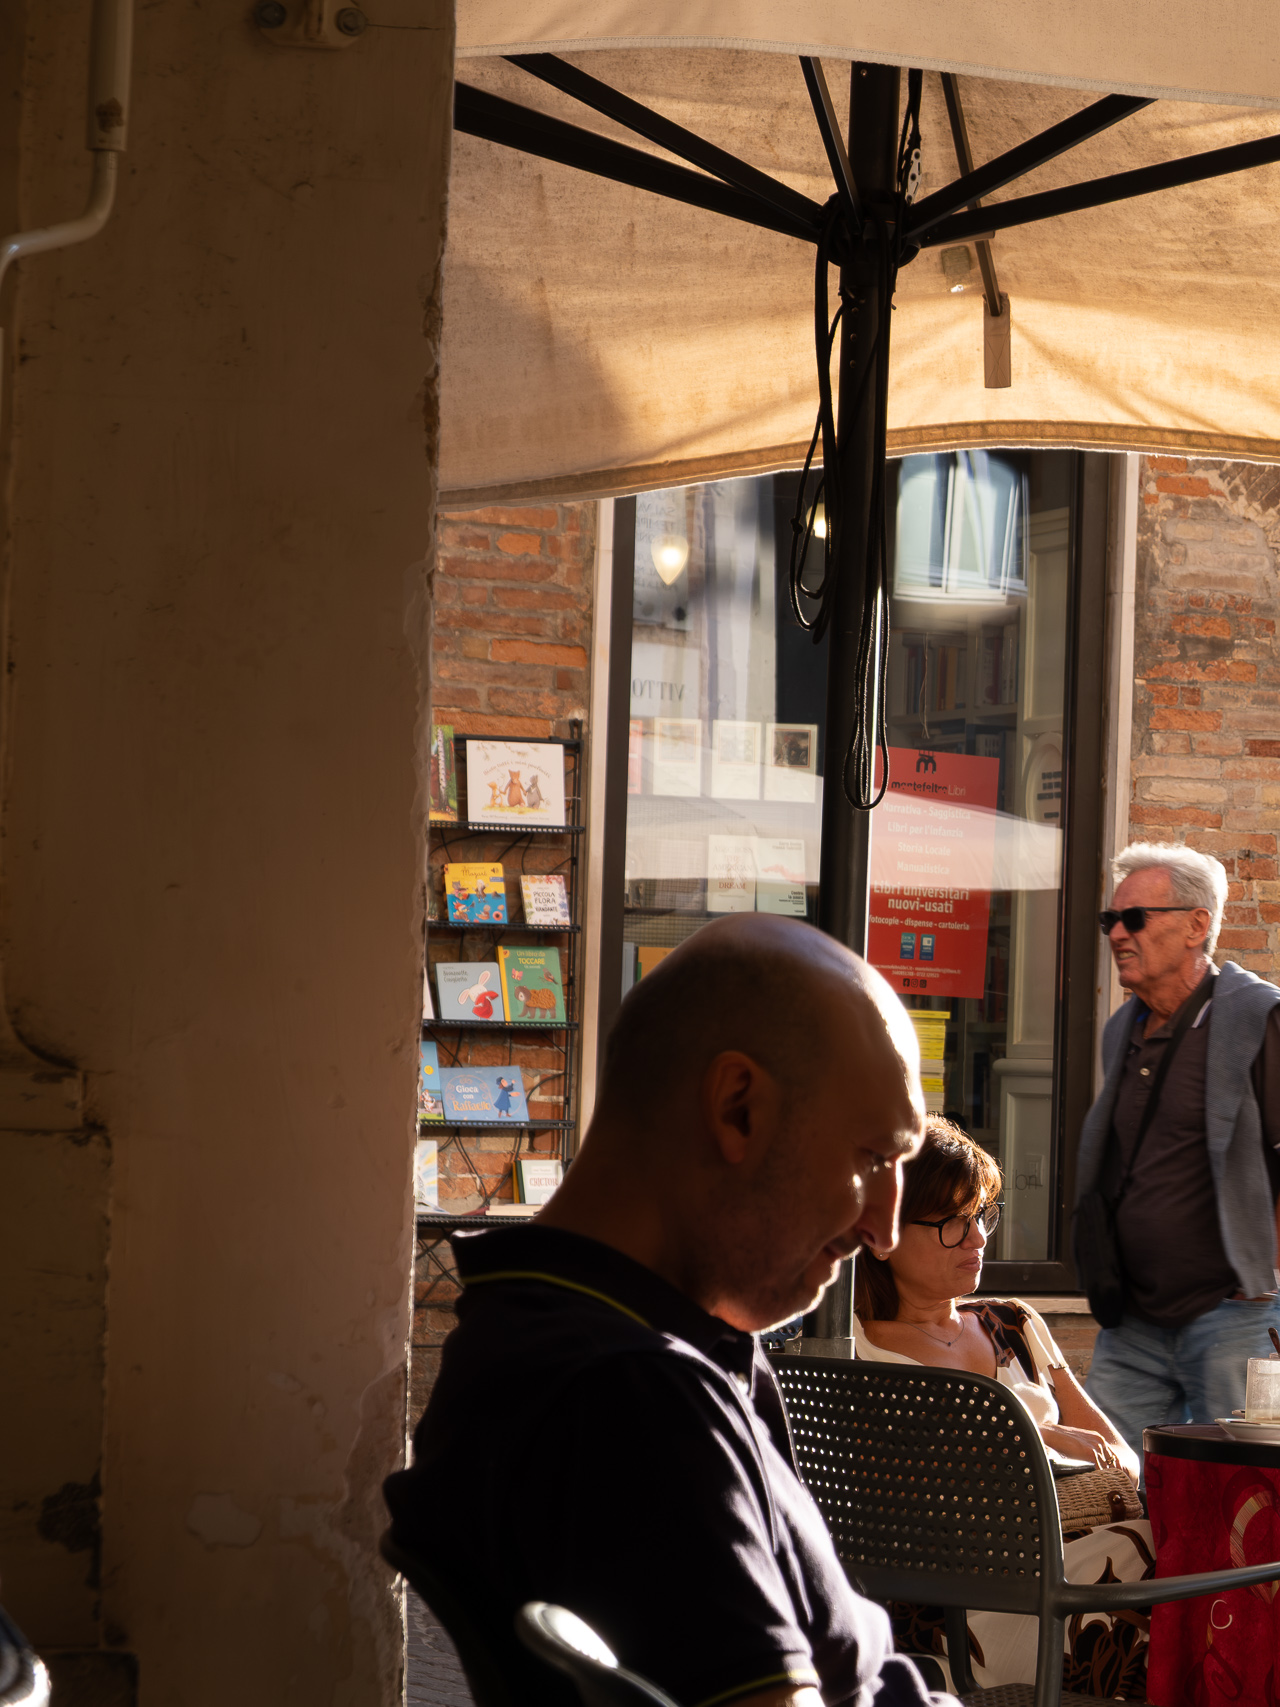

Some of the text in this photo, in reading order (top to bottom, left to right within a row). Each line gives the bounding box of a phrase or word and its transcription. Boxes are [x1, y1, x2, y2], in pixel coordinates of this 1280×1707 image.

[882, 802, 922, 815] Narrativa
[928, 806, 971, 820] Saggistica
[887, 821, 908, 832] Libri
[909, 825, 923, 836] per
[897, 842, 951, 856] Storia Locale
[896, 861, 950, 875] Manualistica
[873, 880, 969, 901] Libri universitari
[887, 897, 954, 914] nuovi-usati
[904, 917, 933, 929] dispense
[938, 920, 970, 931] cartoleria
[518, 957, 546, 965] TOCCARE
[455, 1085, 480, 1094] Gioca
